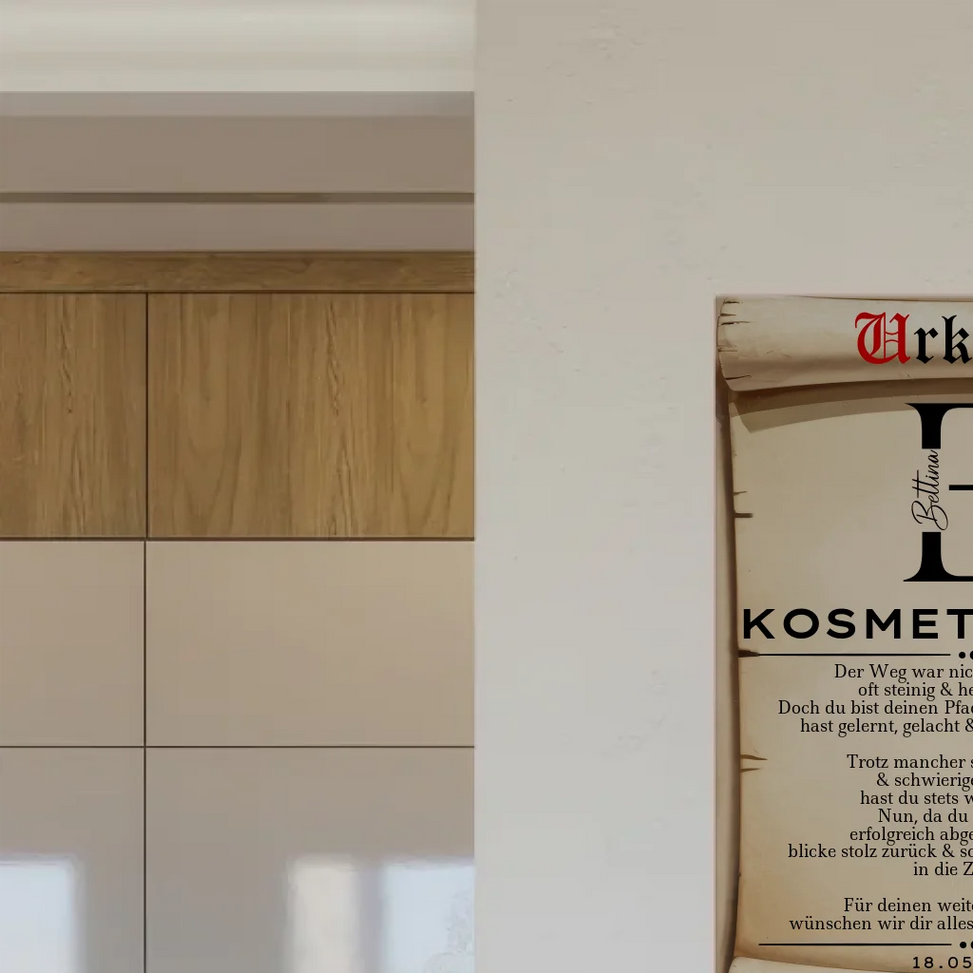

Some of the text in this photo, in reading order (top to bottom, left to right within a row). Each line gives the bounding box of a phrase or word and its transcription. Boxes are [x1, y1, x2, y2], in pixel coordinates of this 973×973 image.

[911, 449, 949, 531] Bettina
[835, 664, 864, 678] Der
[869, 664, 908, 684] Weg
[912, 669, 944, 678] war
[859, 682, 879, 696] oft
[885, 682, 935, 702] steinig
[941, 682, 952, 696] &
[779, 700, 819, 714] Doch
[826, 700, 845, 714] du
[851, 700, 879, 714] bist
[885, 700, 938, 714] deinen
[801, 718, 833, 732] hast
[838, 718, 897, 737] gelernt,
[903, 718, 960, 737] gelacht
[847, 754, 888, 768] Trotz
[894, 754, 966, 768] mancher
[877, 773, 889, 786] &
[861, 790, 893, 804] hast
[899, 790, 918, 804] du
[924, 793, 958, 804] stets
[879, 808, 917, 824] Nun,
[924, 809, 942, 822] da
[948, 809, 968, 822] du
[850, 827, 934, 846] erfolgreich
[788, 844, 836, 857] blicke
[842, 844, 877, 857] stolz
[882, 843, 937, 857] zurück
[943, 844, 955, 857] &
[914, 862, 928, 875] in
[935, 862, 957, 875] die
[844, 898, 872, 911] Für
[878, 898, 931, 911] deinen
[789, 916, 871, 929] wünschen
[878, 916, 905, 929] wir
[910, 916, 932, 929] dir
[938, 916, 973, 929] alles
